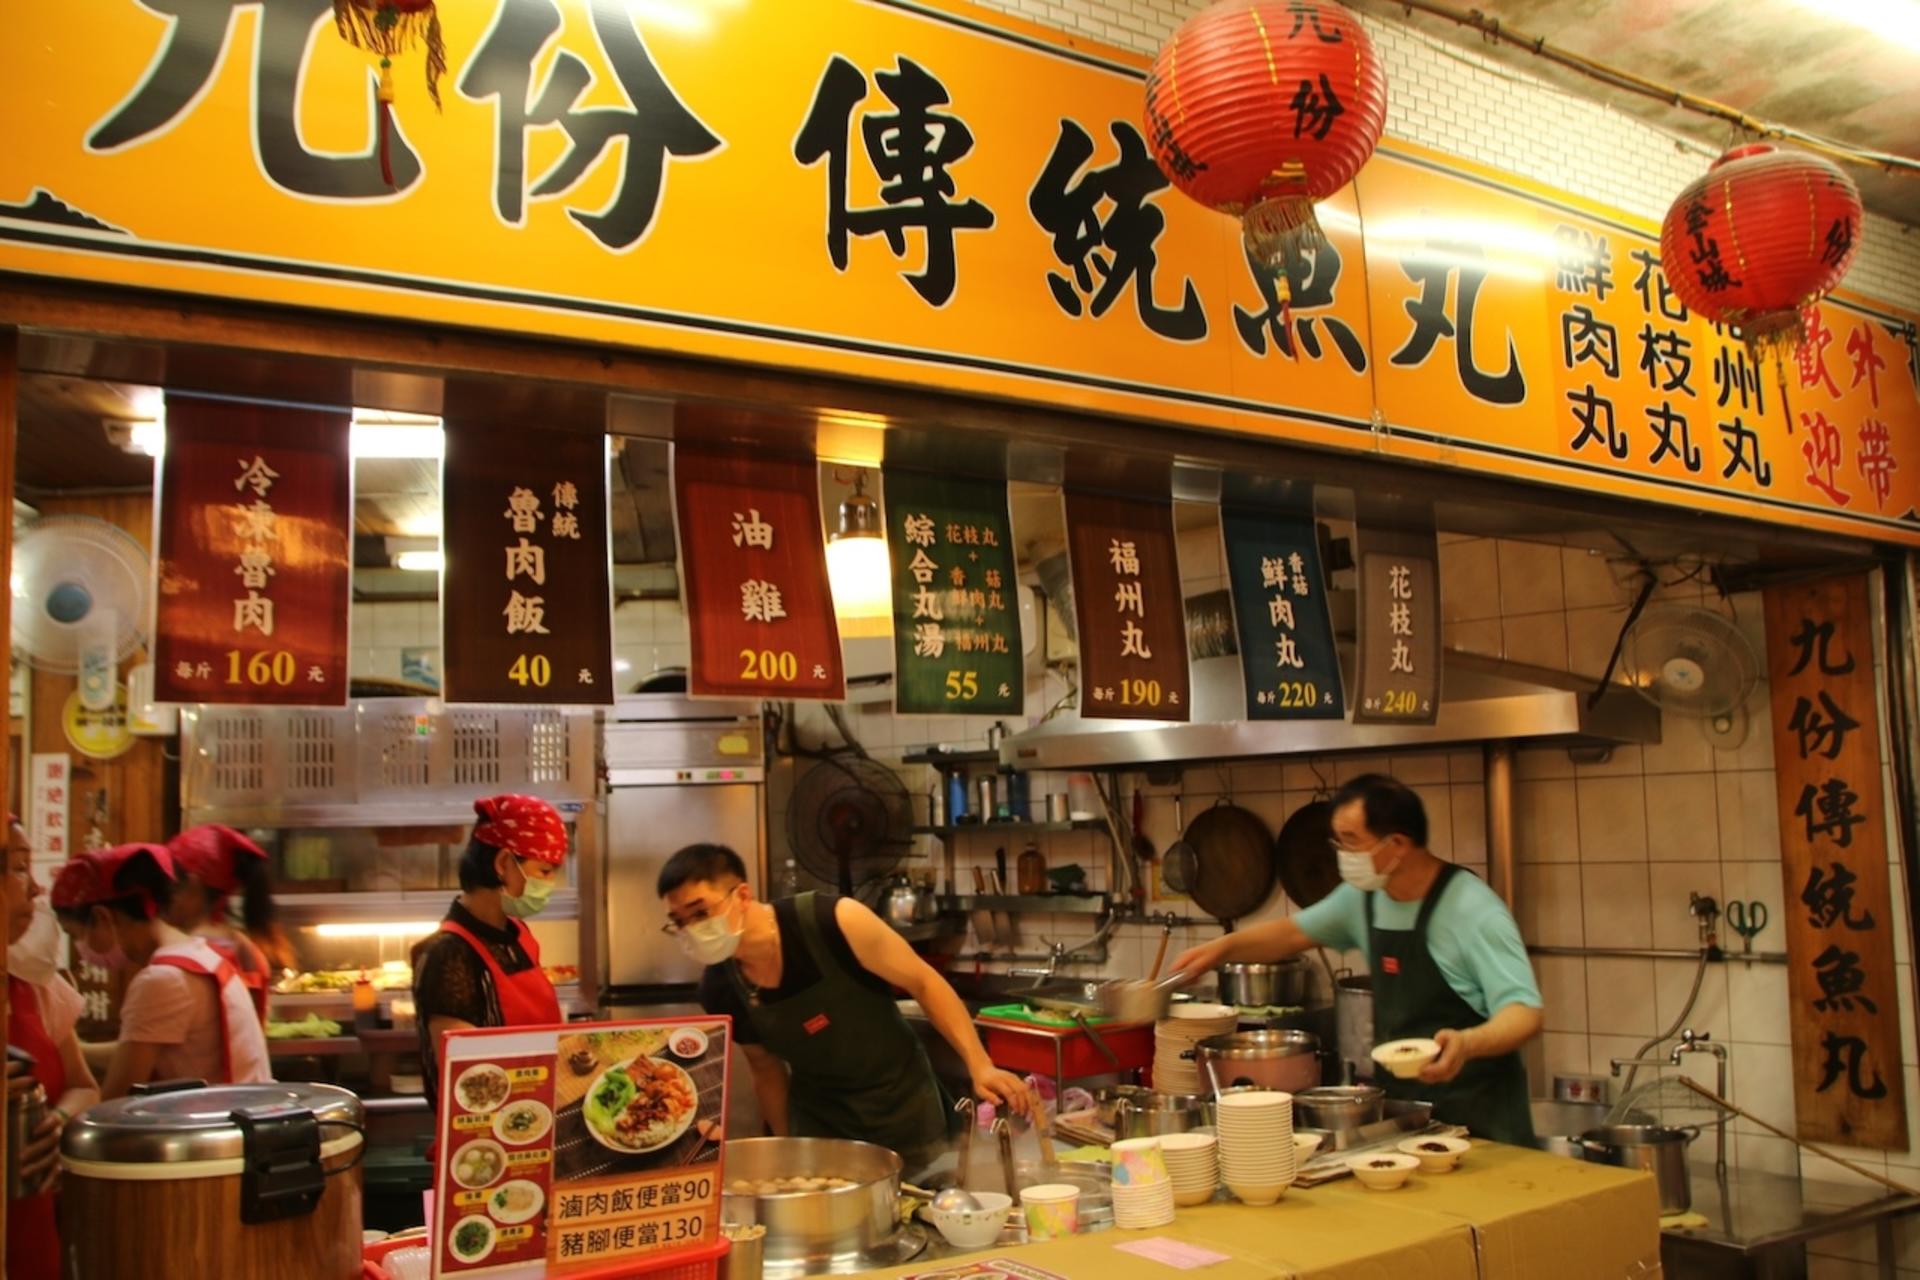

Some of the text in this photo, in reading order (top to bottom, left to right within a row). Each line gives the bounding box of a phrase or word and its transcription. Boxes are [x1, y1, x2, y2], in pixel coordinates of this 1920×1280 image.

[1554, 222, 1630, 459] 鮮肉丸
[1631, 248, 1702, 472] 花枝丸
[1794, 306, 1850, 506] 歡迎
[1846, 320, 1897, 511] 外帶
[551, 480, 581, 541] 傳統
[944, 523, 998, 547] 花枝丸
[502, 486, 551, 635] 魯肉飯
[730, 508, 787, 623] 油雞
[1287, 551, 1309, 596] 香菇
[903, 512, 945, 659] 綜合丸湯
[951, 588, 1005, 610] 鮮肉丸
[1109, 537, 1152, 660] 福州丸
[1260, 554, 1304, 669] 鮮肉丸
[1388, 565, 1414, 674] 花枝丸
[738, 648, 827, 682] 200 元
[954, 631, 1009, 654] 福州丸
[175, 650, 325, 685] 每斤 160 元
[507, 653, 594, 688] 40 元
[945, 670, 1011, 700] 55 元
[1119, 678, 1161, 707] 190
[1168, 690, 1179, 705] 元
[1278, 681, 1317, 709] 220
[1323, 691, 1333, 705] 元
[1383, 689, 1417, 713] 240
[1786, 617, 1888, 1101] 九份傳統魚丸
[558, 1178, 711, 1221] 滷肉飯便當90
[560, 1215, 703, 1258] 豬腳便當130
